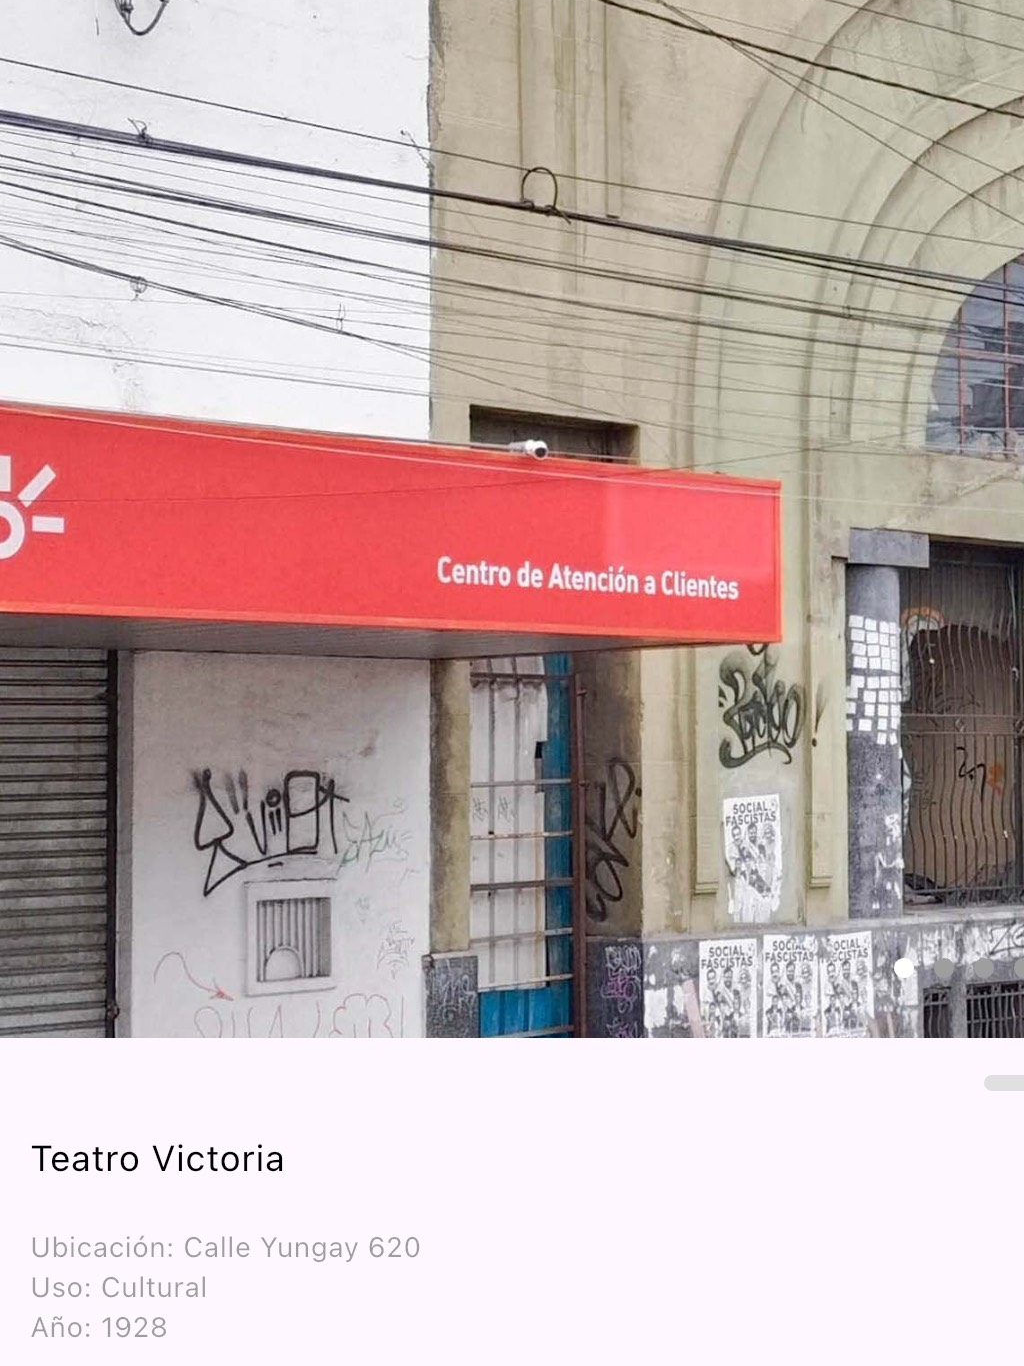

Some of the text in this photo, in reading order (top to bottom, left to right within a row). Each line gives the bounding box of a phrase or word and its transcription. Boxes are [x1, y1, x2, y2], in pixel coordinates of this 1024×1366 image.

[437, 556, 739, 600] Centro de Atención a Clientes
[725, 811, 776, 827] FASCISTAS
[701, 956, 753, 970] FASCISTAS
[765, 951, 815, 963] FASCISTAS
